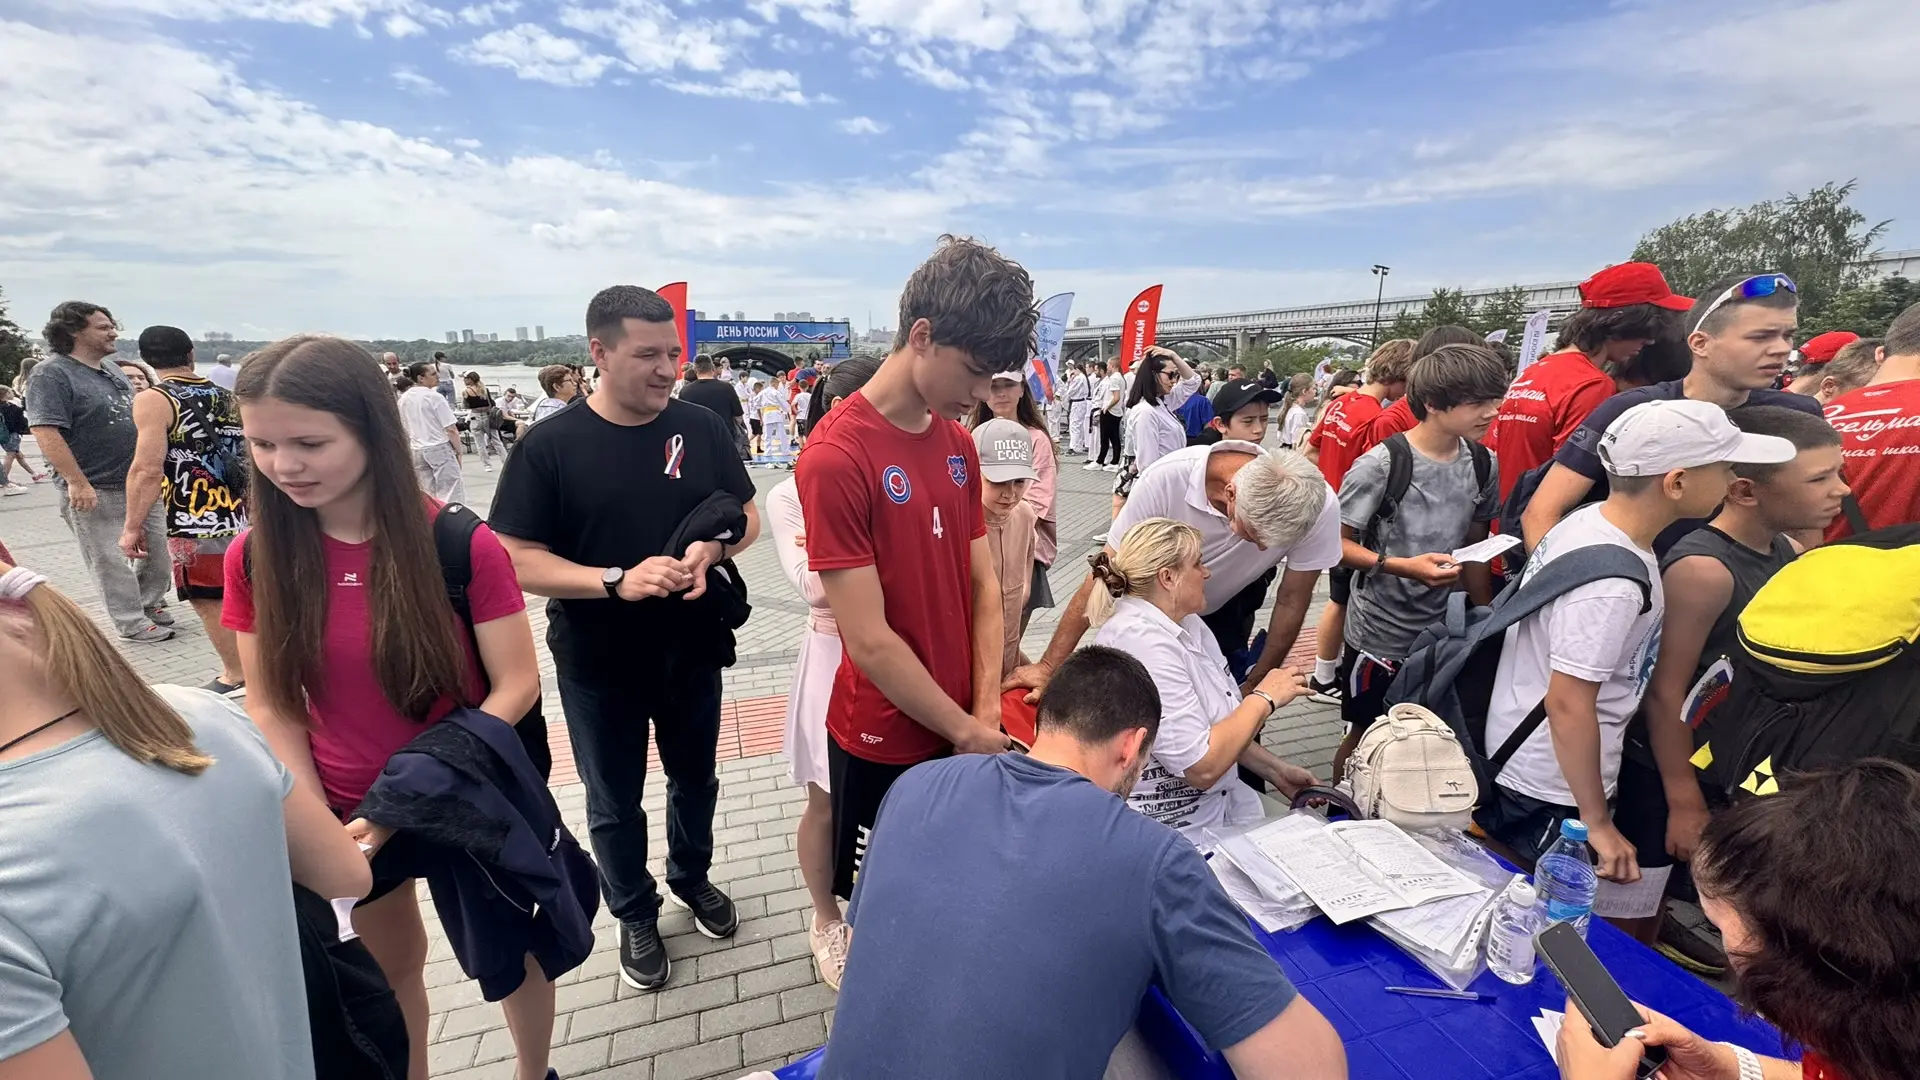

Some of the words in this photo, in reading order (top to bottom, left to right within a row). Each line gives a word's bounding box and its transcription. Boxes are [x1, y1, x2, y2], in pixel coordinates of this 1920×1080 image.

[716, 325, 741, 338] ДЕНЬ
[743, 326, 779, 338] РОССИИ
[1132, 319, 1146, 361] УСИНКАЙ
[997, 449, 1028, 460] CODE
[932, 506, 944, 539] 4
